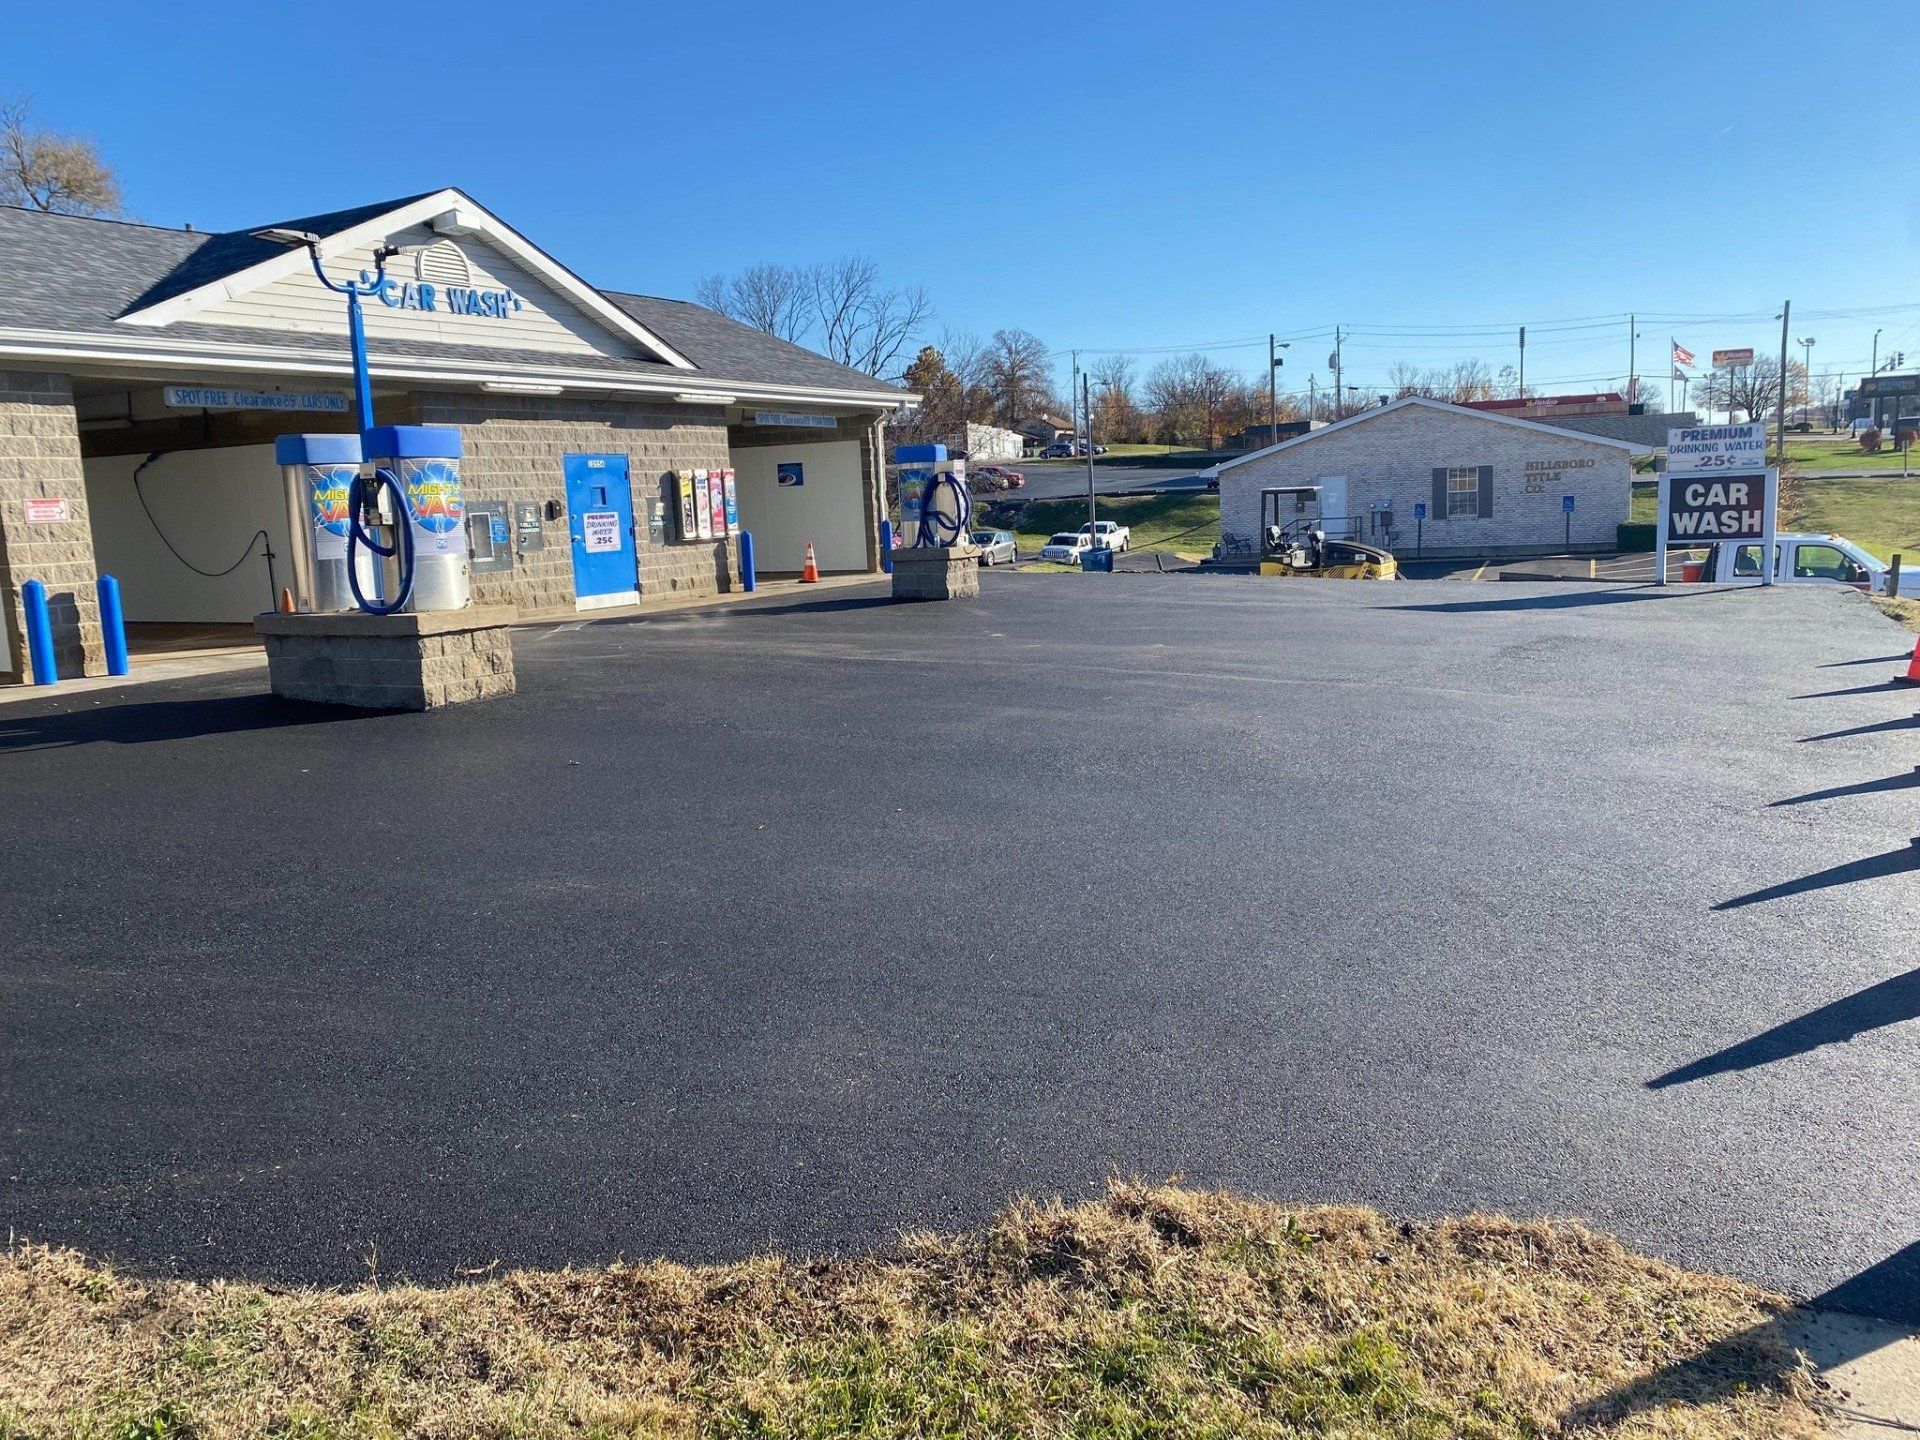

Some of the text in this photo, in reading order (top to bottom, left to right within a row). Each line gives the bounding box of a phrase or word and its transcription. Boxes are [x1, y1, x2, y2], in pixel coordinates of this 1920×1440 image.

[175, 389, 200, 404] SPOT
[204, 390, 228, 406] FREE
[234, 391, 282, 407] Clearance
[302, 393, 322, 408] CARS
[324, 394, 346, 409] ONLY
[1680, 427, 1753, 441] PREMIUM
[1669, 441, 1763, 454] DRINKING WATER
[1525, 459, 1595, 470] HILLSBORO
[1525, 472, 1561, 481] TITLE
[314, 489, 350, 501] MIGH
[408, 482, 460, 495] MIGHTY
[1685, 483, 1749, 507] CAR
[317, 501, 350, 523] VA
[411, 497, 462, 517] VAC
[586, 521, 617, 529] DRINKING
[1672, 510, 1762, 535] WASH
